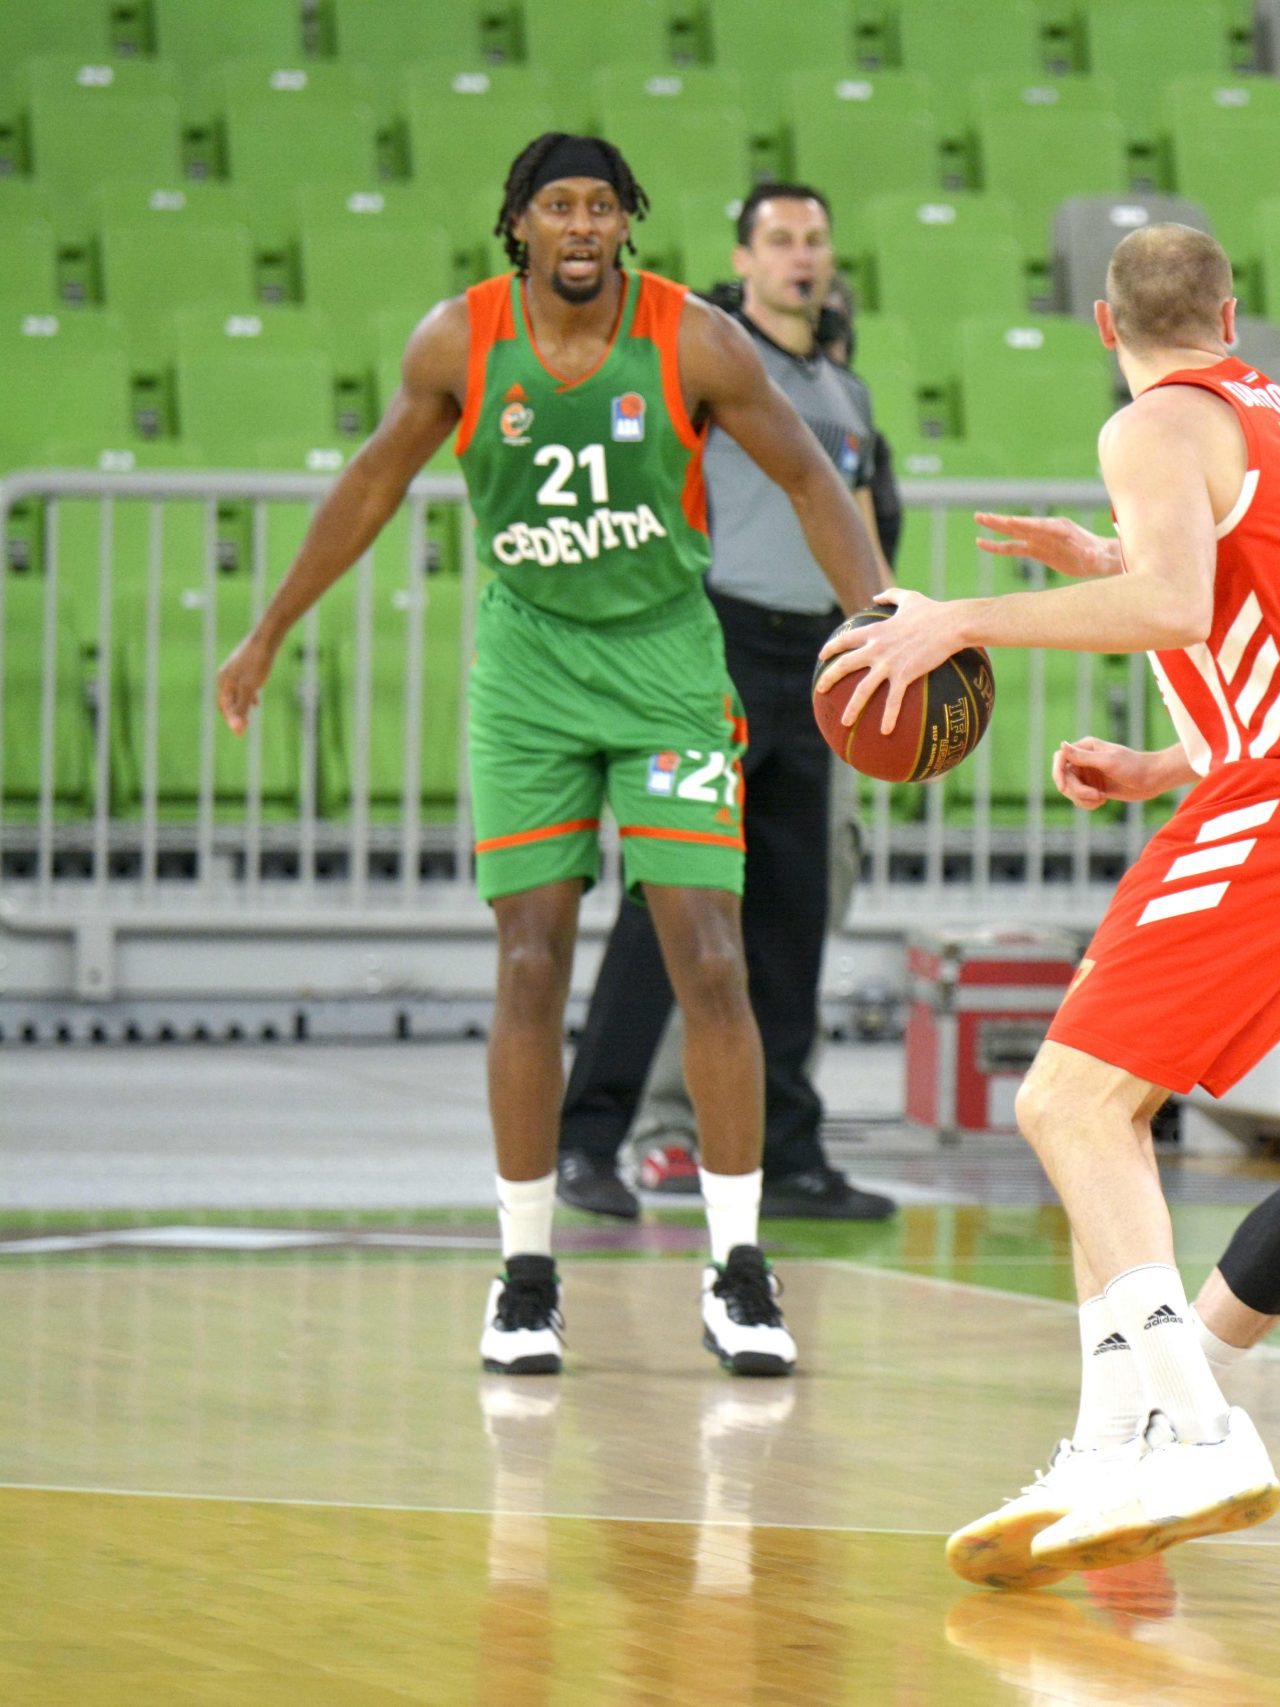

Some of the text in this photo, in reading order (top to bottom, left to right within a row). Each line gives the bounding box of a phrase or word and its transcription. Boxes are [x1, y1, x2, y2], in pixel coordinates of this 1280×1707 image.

[534, 444, 609, 507] 21
[493, 504, 668, 567] CEDEVITA
[1143, 1314, 1184, 1330] adidas
